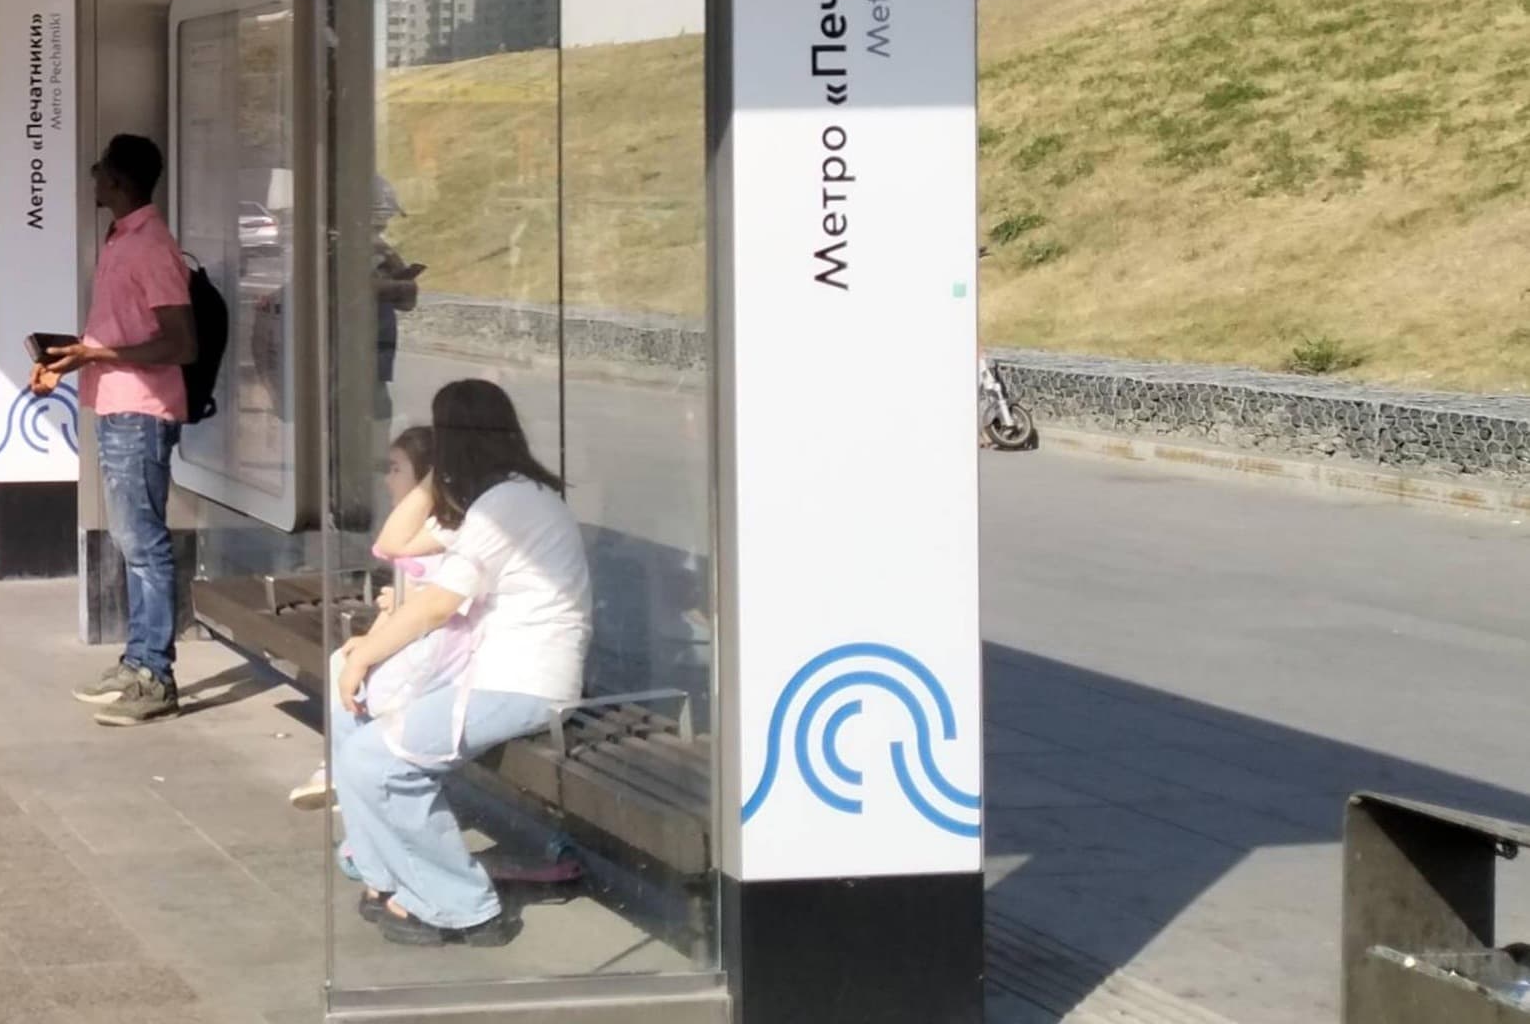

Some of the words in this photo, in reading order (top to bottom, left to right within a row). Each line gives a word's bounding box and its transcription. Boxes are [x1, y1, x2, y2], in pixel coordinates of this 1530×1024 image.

[26, 13, 44, 151] «Печатники»
[49, 12, 62, 84] Pechatniki
[50, 87, 62, 131] Metro
[27, 158, 47, 230] Метро
[812, 125, 856, 291] Метро
